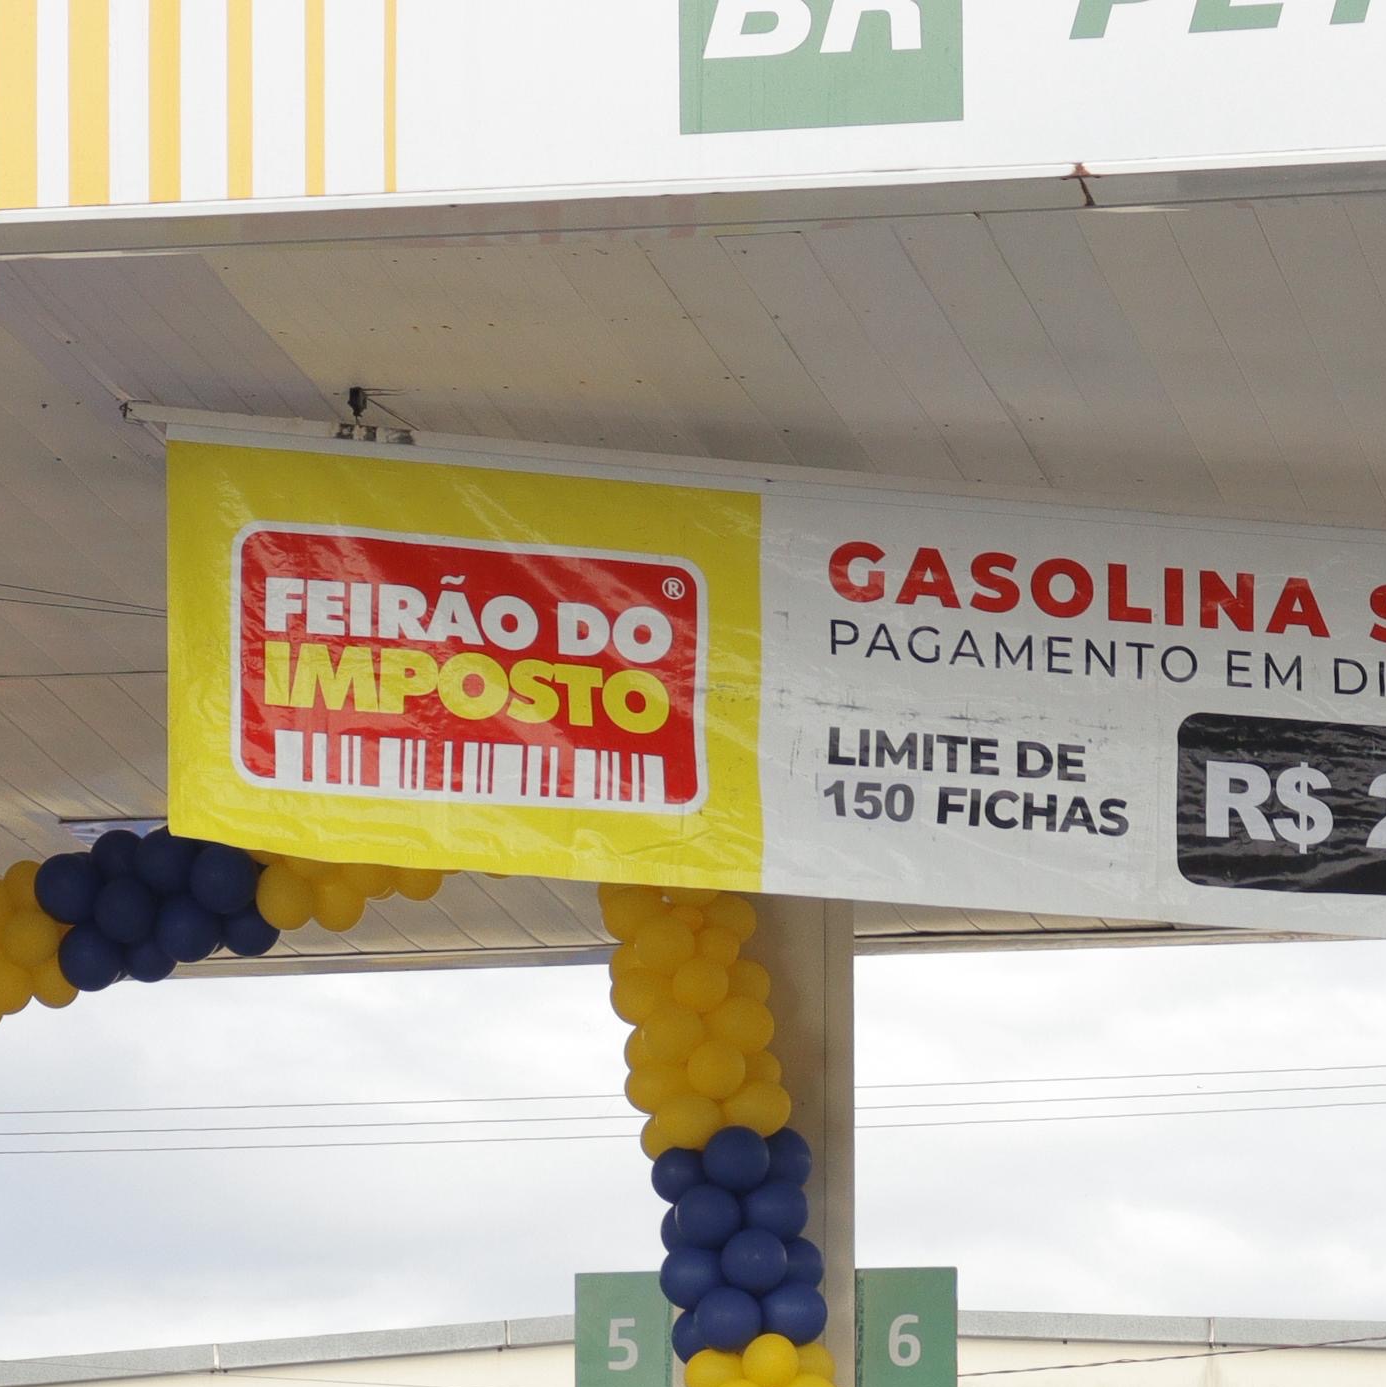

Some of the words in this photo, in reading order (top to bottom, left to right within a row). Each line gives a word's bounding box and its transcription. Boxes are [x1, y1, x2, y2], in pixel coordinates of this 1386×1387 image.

[265, 575, 539, 651] FEIRÃO
[557, 602, 673, 663] DO
[828, 541, 1330, 639] GASOLINA
[264, 642, 670, 734] IMPOSTO
[829, 618, 1198, 684] PAGAMENTO
[1226, 651, 1303, 691] EM
[828, 727, 1000, 776] LIMITE
[1017, 740, 1087, 782] DE
[823, 780, 914, 823] 150
[936, 786, 1130, 837] FICHAS
[1205, 760, 1333, 854] R$
[607, 1317, 639, 1371] 5
[888, 1314, 922, 1367] 6
